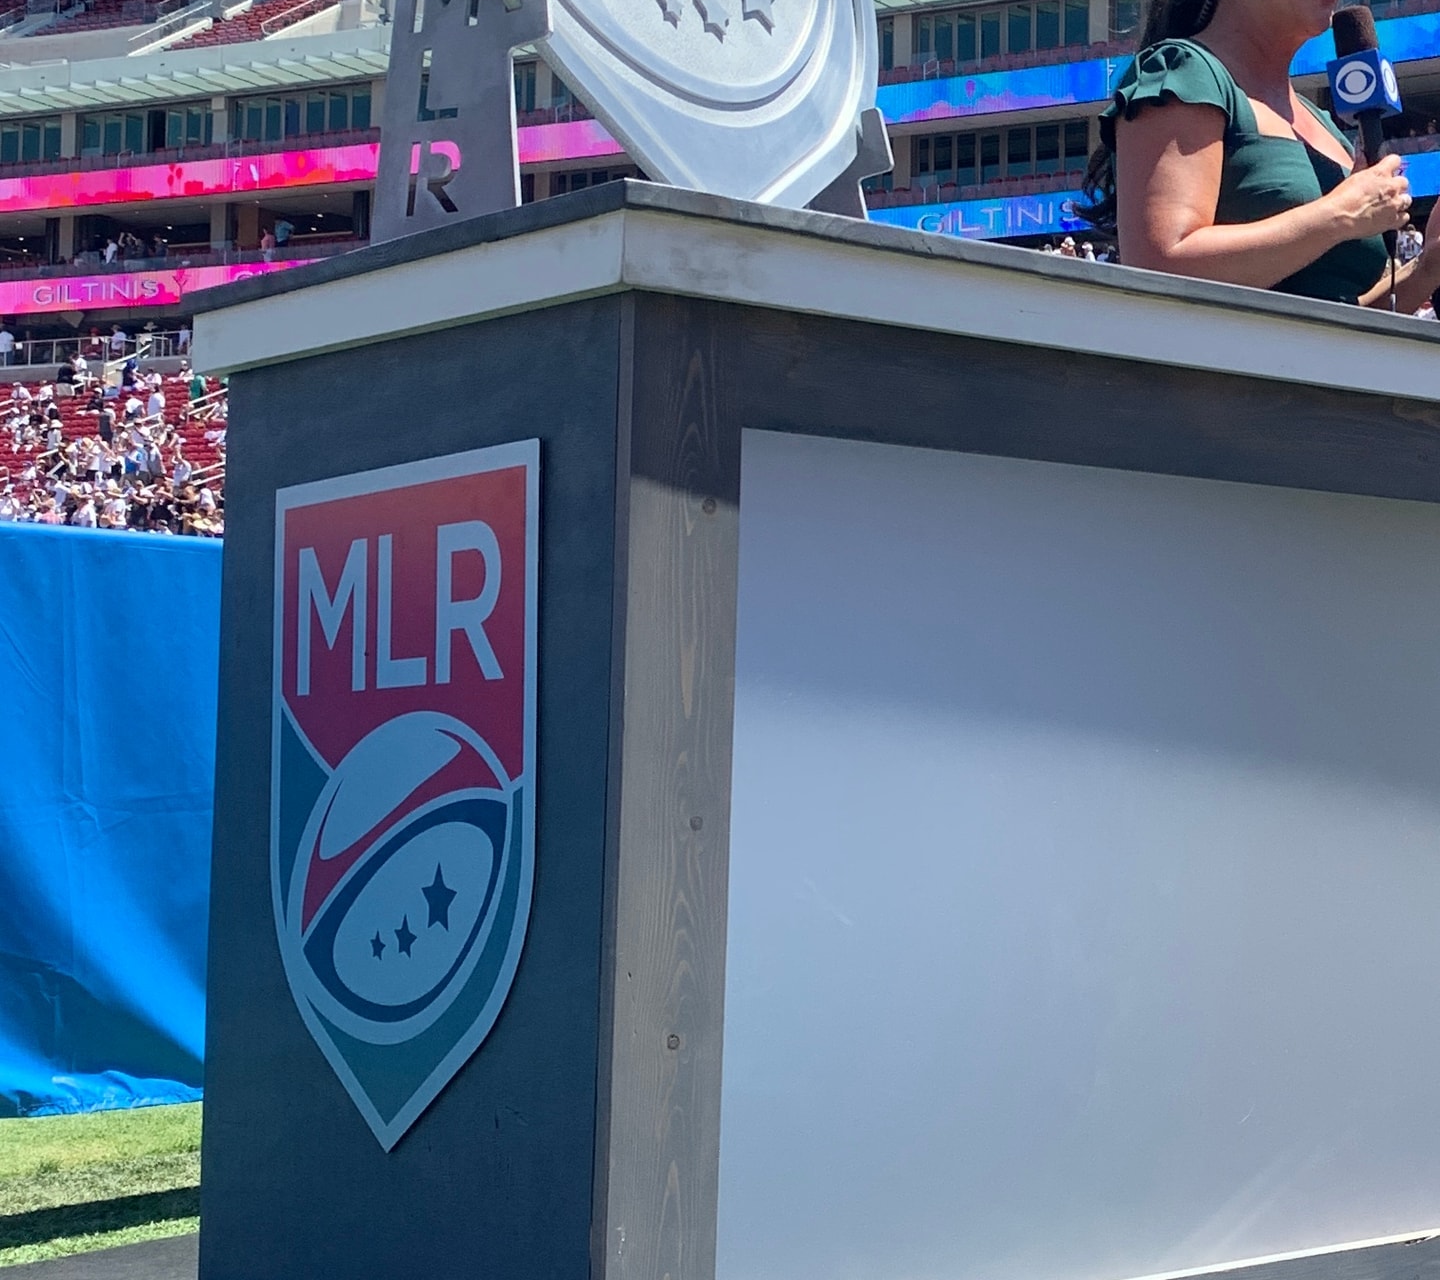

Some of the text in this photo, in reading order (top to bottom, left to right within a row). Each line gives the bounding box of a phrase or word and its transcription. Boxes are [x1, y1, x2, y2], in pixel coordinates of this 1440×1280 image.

[916, 197, 1082, 235] GILTINIS
[32, 279, 159, 306] GILTINIS
[297, 519, 505, 697] MLR
